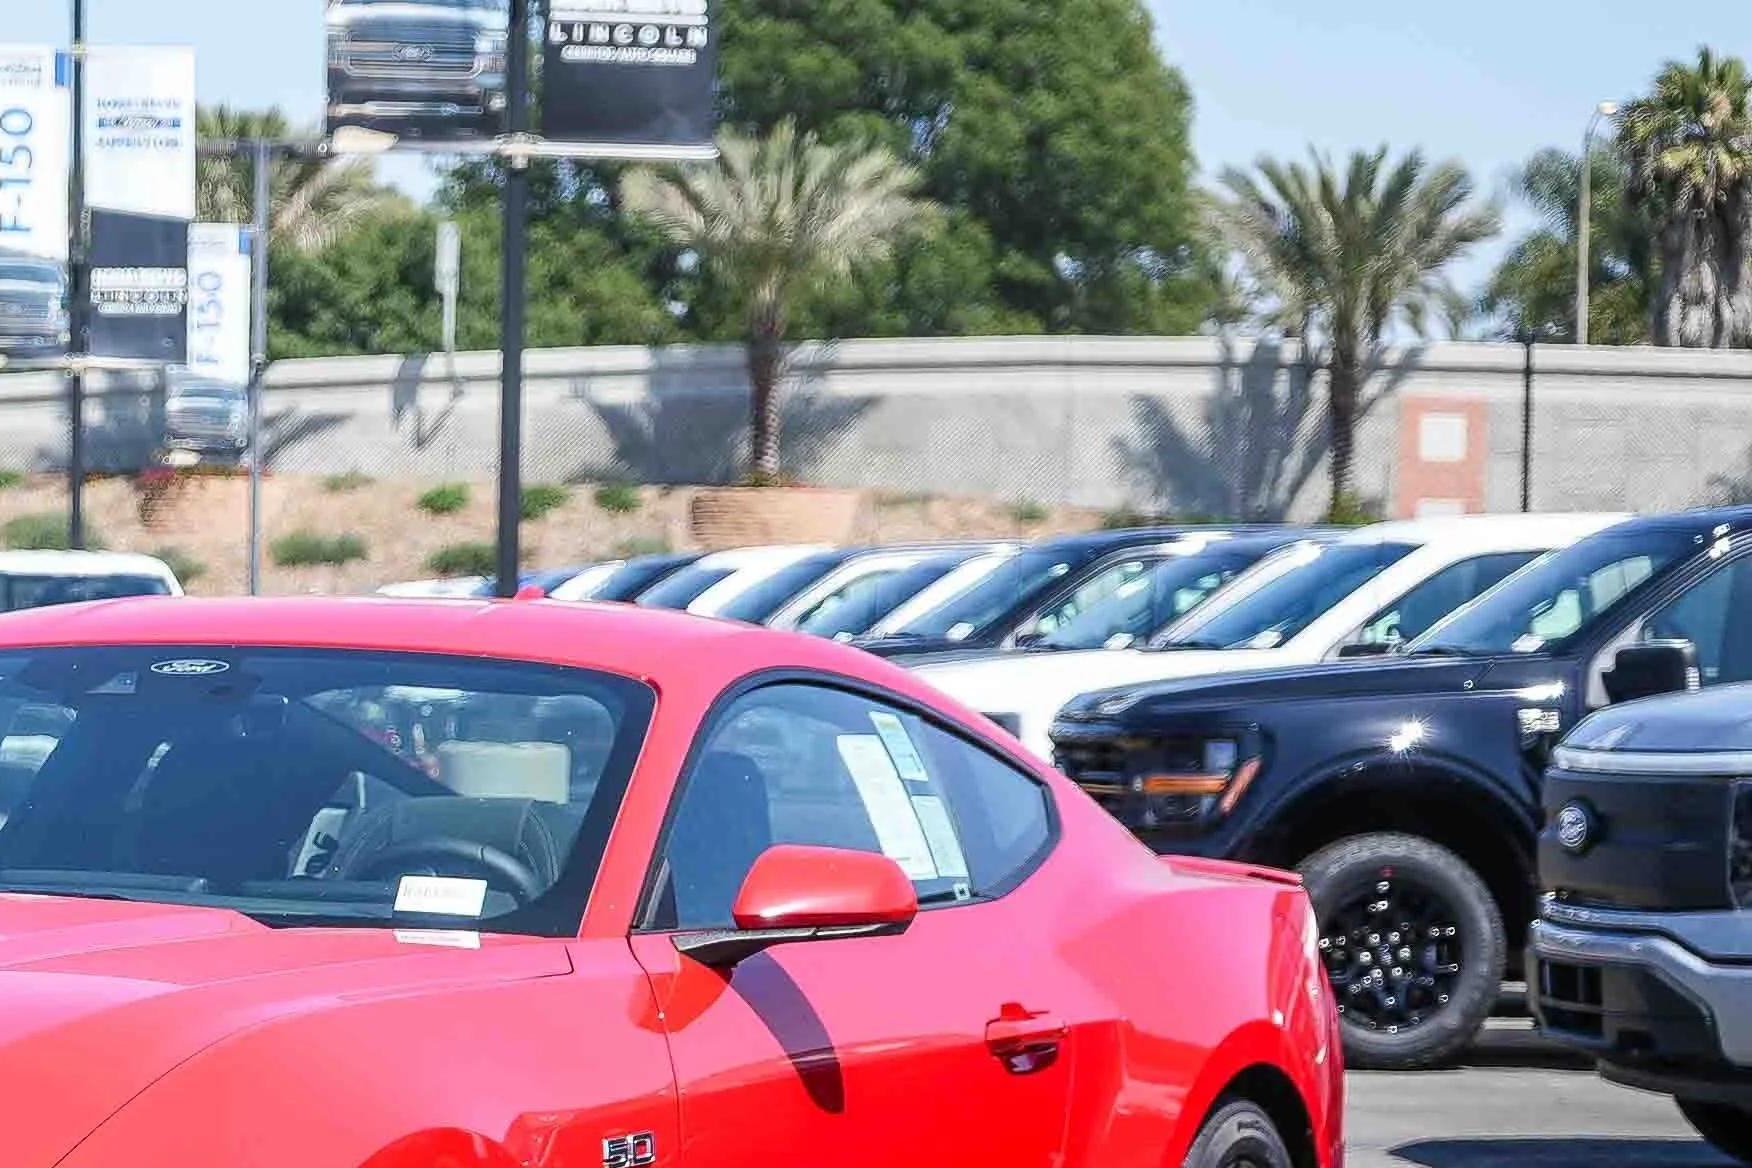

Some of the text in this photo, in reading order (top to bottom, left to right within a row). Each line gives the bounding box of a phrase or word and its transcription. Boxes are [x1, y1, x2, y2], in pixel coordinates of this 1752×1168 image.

[549, 22, 708, 48] LINCOLN
[0, 108, 33, 233] F-150
[196, 270, 222, 366] F-150
